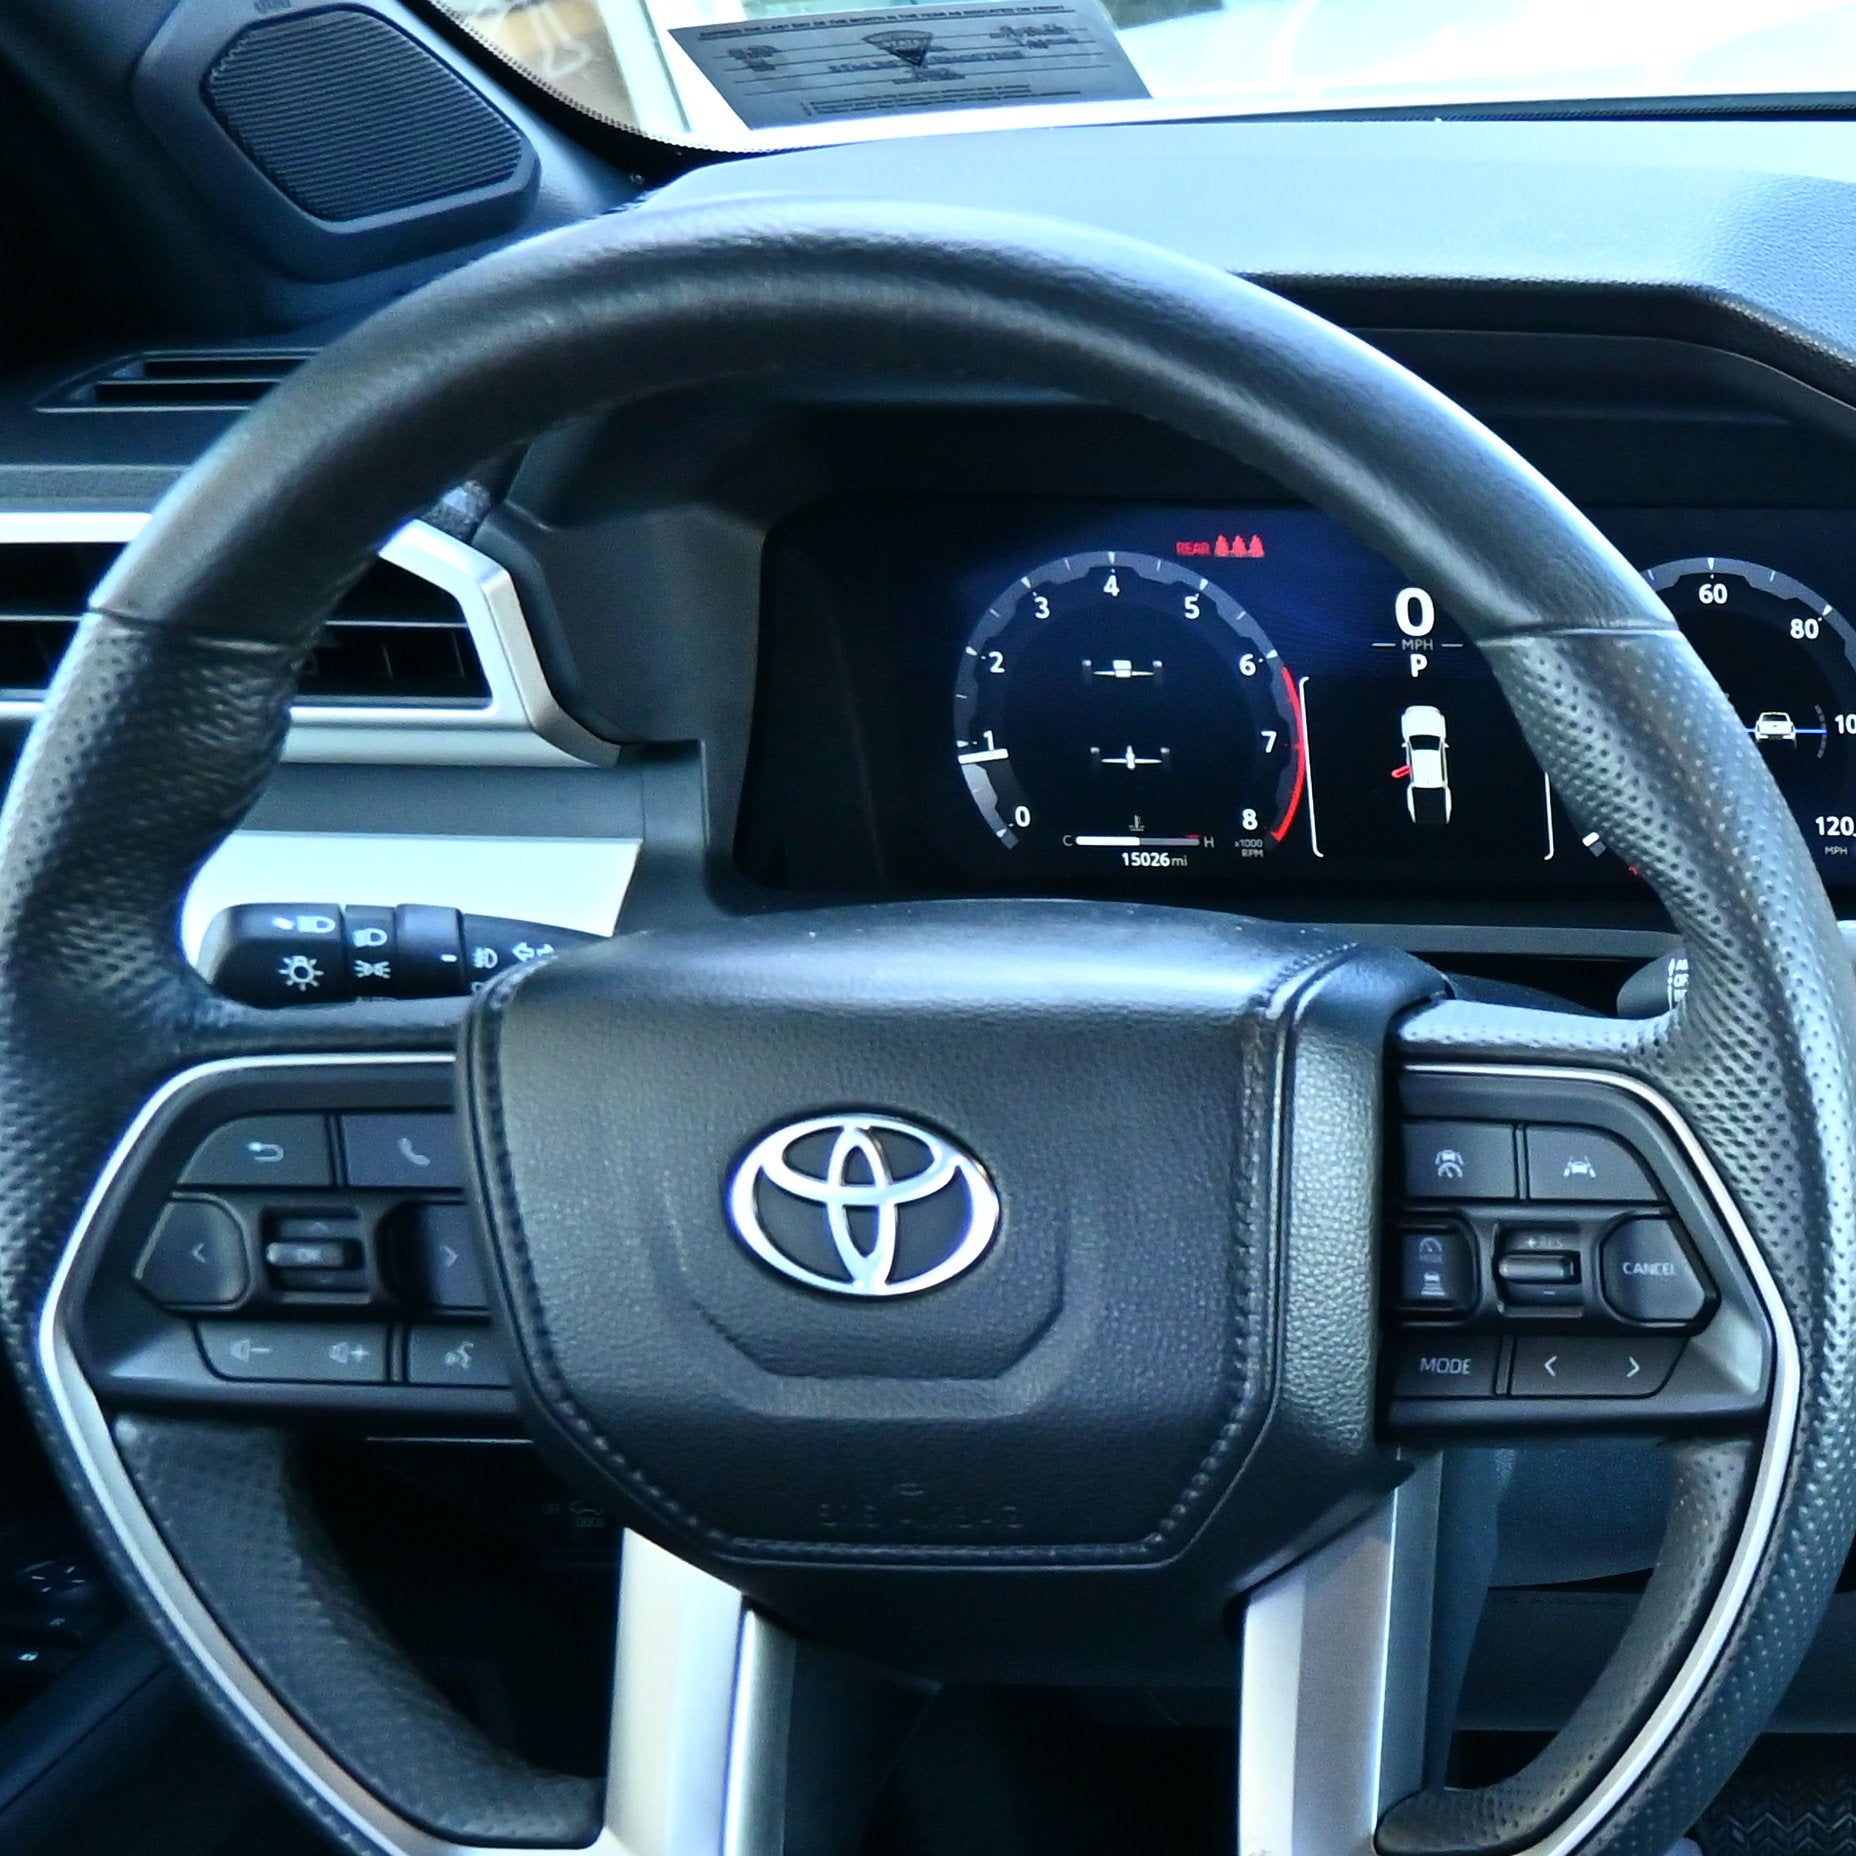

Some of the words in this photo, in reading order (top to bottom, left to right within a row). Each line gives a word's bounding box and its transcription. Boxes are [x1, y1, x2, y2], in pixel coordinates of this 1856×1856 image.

[1176, 542, 1210, 557] REAR
[1103, 574, 1120, 597] 4
[1698, 583, 1728, 605] 60
[1034, 596, 1051, 619] 3
[1184, 594, 1200, 619] 5
[1395, 587, 1435, 637] 0
[1790, 618, 1820, 641] 80
[1401, 638, 1434, 651] MPH
[988, 650, 1006, 674] 2
[1239, 654, 1256, 676] 6
[1410, 654, 1427, 678] P
[982, 730, 995, 751] 1
[1261, 730, 1277, 754] 7
[1014, 805, 1031, 828] 0
[1242, 808, 1258, 831] 8
[1814, 815, 1855, 838] 120
[1062, 834, 1073, 848] C
[1203, 836, 1214, 848] H
[1121, 852, 1170, 868] 15026
[1171, 854, 1188, 867] mi
[1622, 1261, 1677, 1276] CANCEL
[1420, 1357, 1472, 1375] MODE
